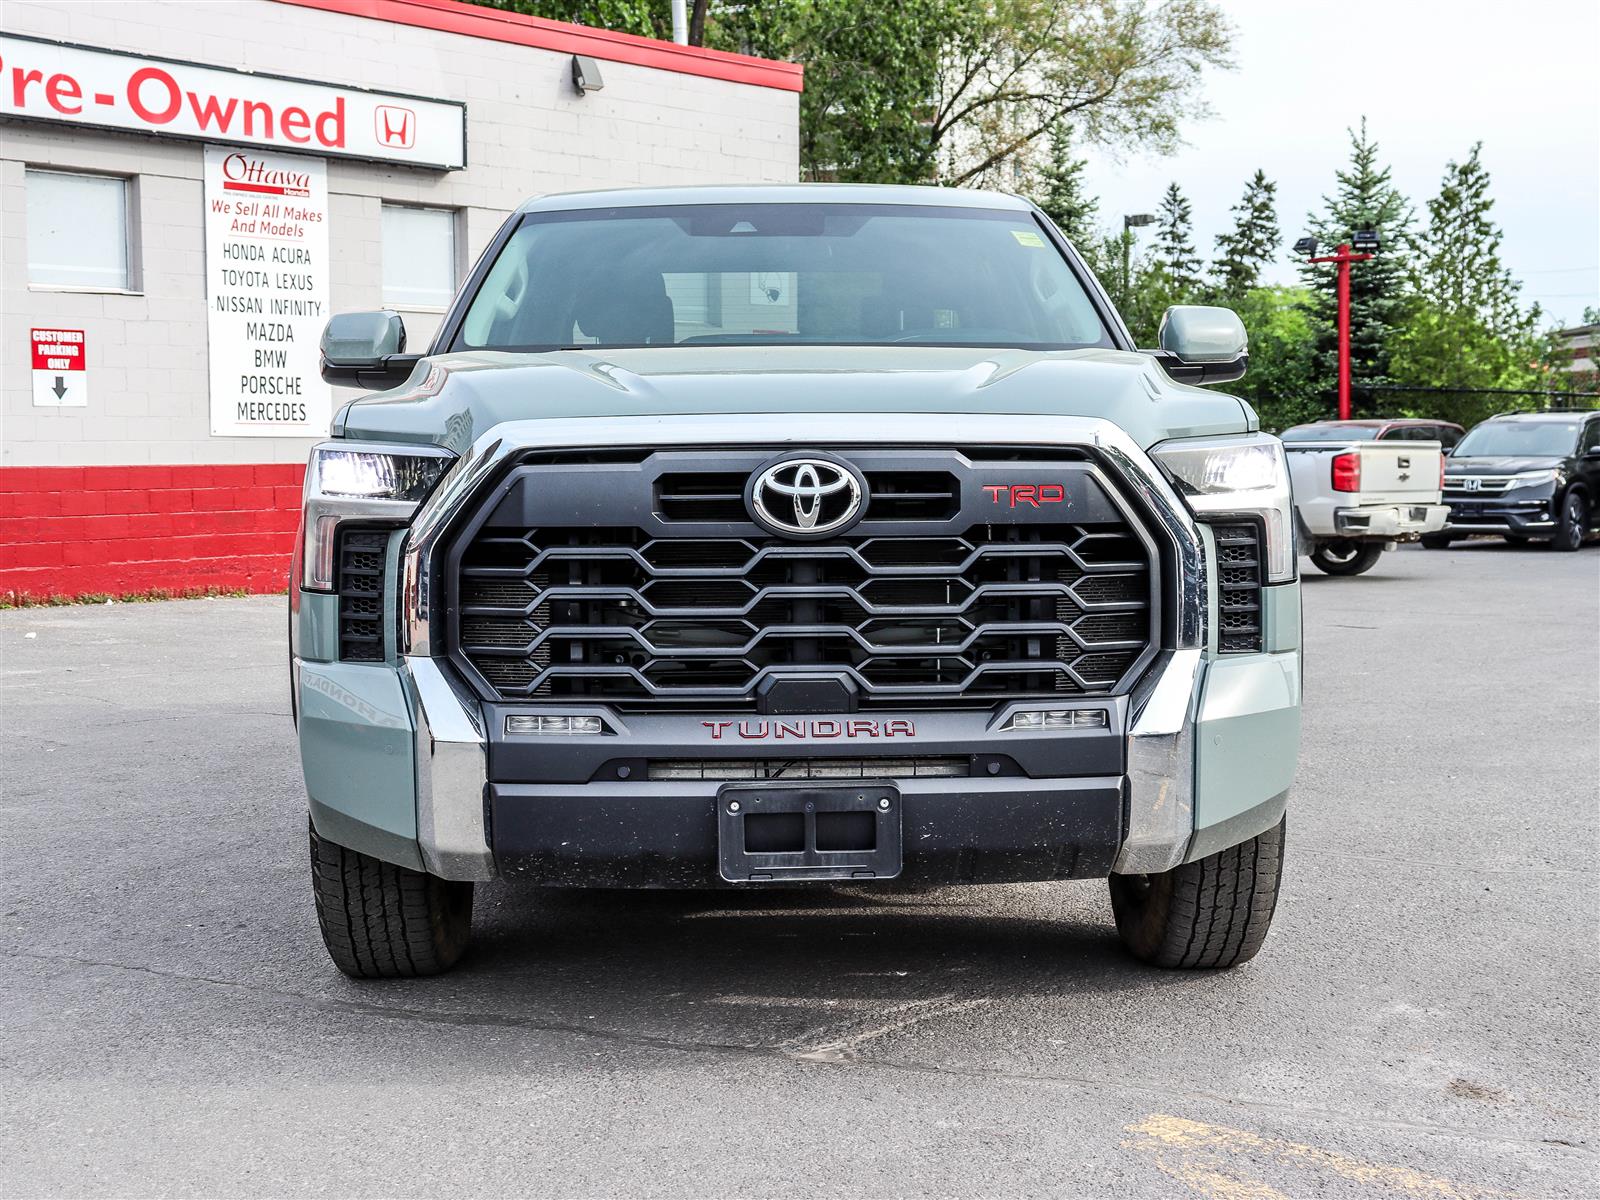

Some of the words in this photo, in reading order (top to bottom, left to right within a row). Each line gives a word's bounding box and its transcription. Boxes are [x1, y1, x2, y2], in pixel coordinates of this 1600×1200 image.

[0, 55, 346, 148] re-Owned
[223, 152, 310, 188] Ottawa
[212, 200, 231, 214] We
[235, 202, 259, 216] Sell
[263, 205, 280, 218] All
[283, 206, 322, 222] Makes
[231, 219, 256, 233] And
[260, 221, 304, 237] Models
[223, 243, 265, 261] HONDA
[272, 247, 311, 265] ACURA
[222, 269, 269, 288] TOYOTA
[276, 273, 313, 290] LEXUS
[217, 296, 262, 314] NISSAN
[270, 299, 321, 316] INFINITY
[32, 330, 83, 343] CUSTOMER
[247, 322, 294, 342] MAZDA
[38, 344, 79, 356] PARKING
[255, 349, 287, 368] BMW
[47, 358, 71, 369] ONLY
[241, 375, 302, 395] PORSCHE
[238, 402, 306, 421] MERCEDES
[982, 484, 1064, 508] TRD
[702, 719, 916, 739] TUNDRA
